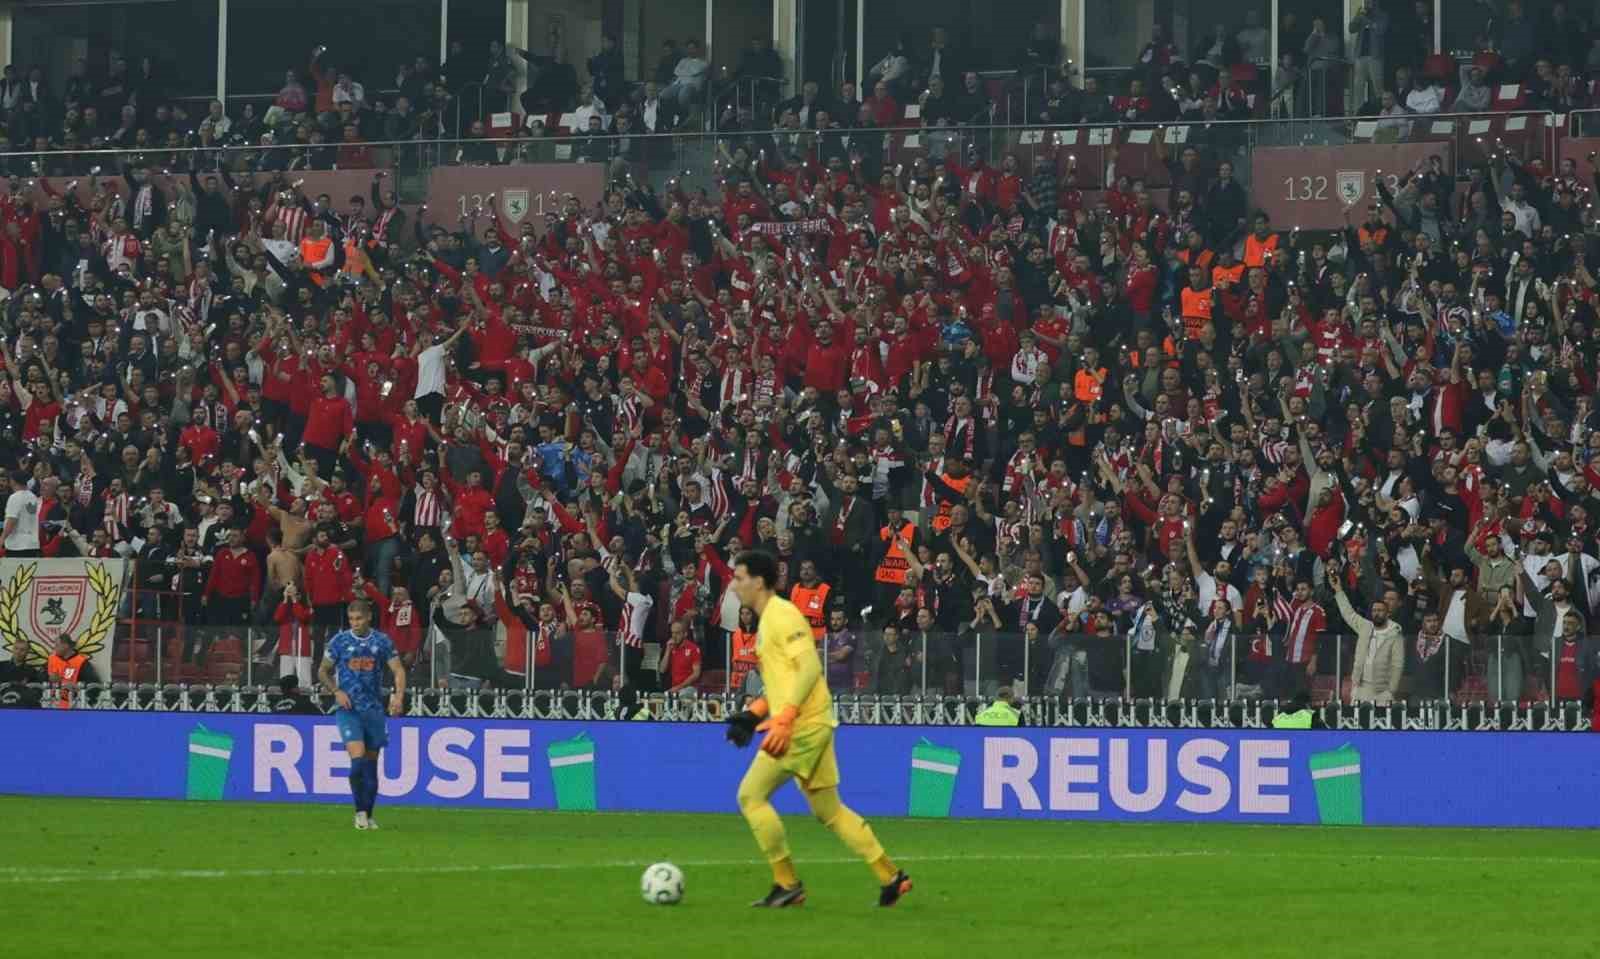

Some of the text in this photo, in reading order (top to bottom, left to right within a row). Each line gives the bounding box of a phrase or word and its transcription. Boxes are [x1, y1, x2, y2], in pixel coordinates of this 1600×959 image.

[1284, 175, 1328, 200] 132
[253, 723, 531, 799] REUSE
[983, 736, 1290, 814] REUSE
